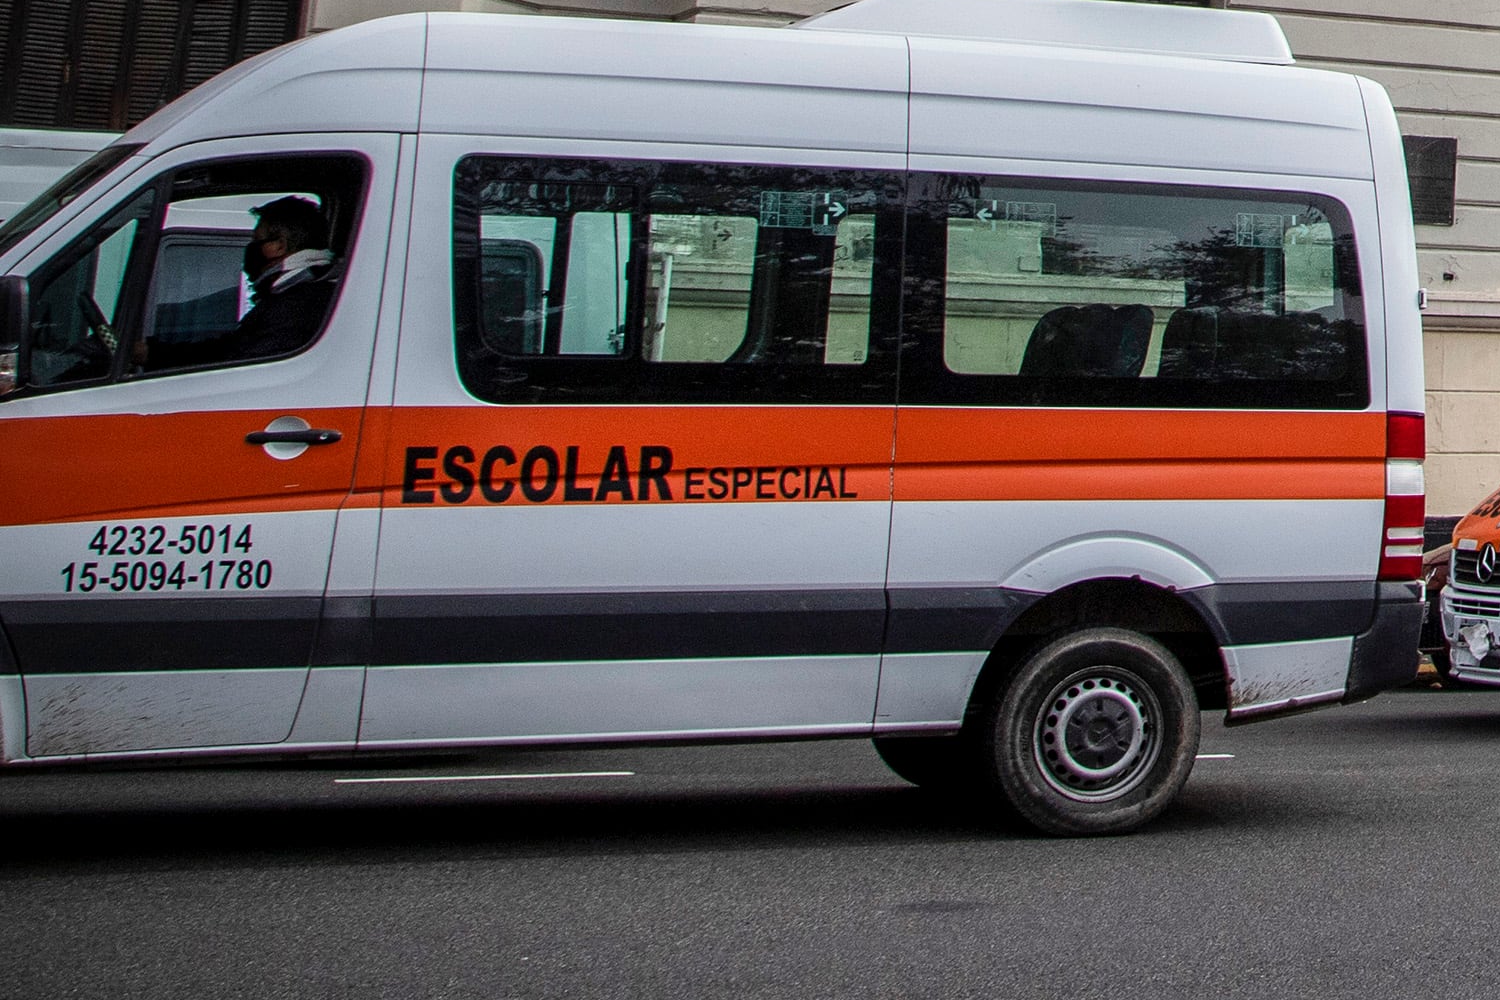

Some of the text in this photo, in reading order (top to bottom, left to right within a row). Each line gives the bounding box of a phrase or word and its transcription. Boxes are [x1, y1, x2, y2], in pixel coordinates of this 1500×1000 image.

[402, 445, 859, 504] ESCOLAR ESPECIAL
[88, 523, 253, 556] 4232-5014
[60, 558, 273, 593] 15-5094-1780
